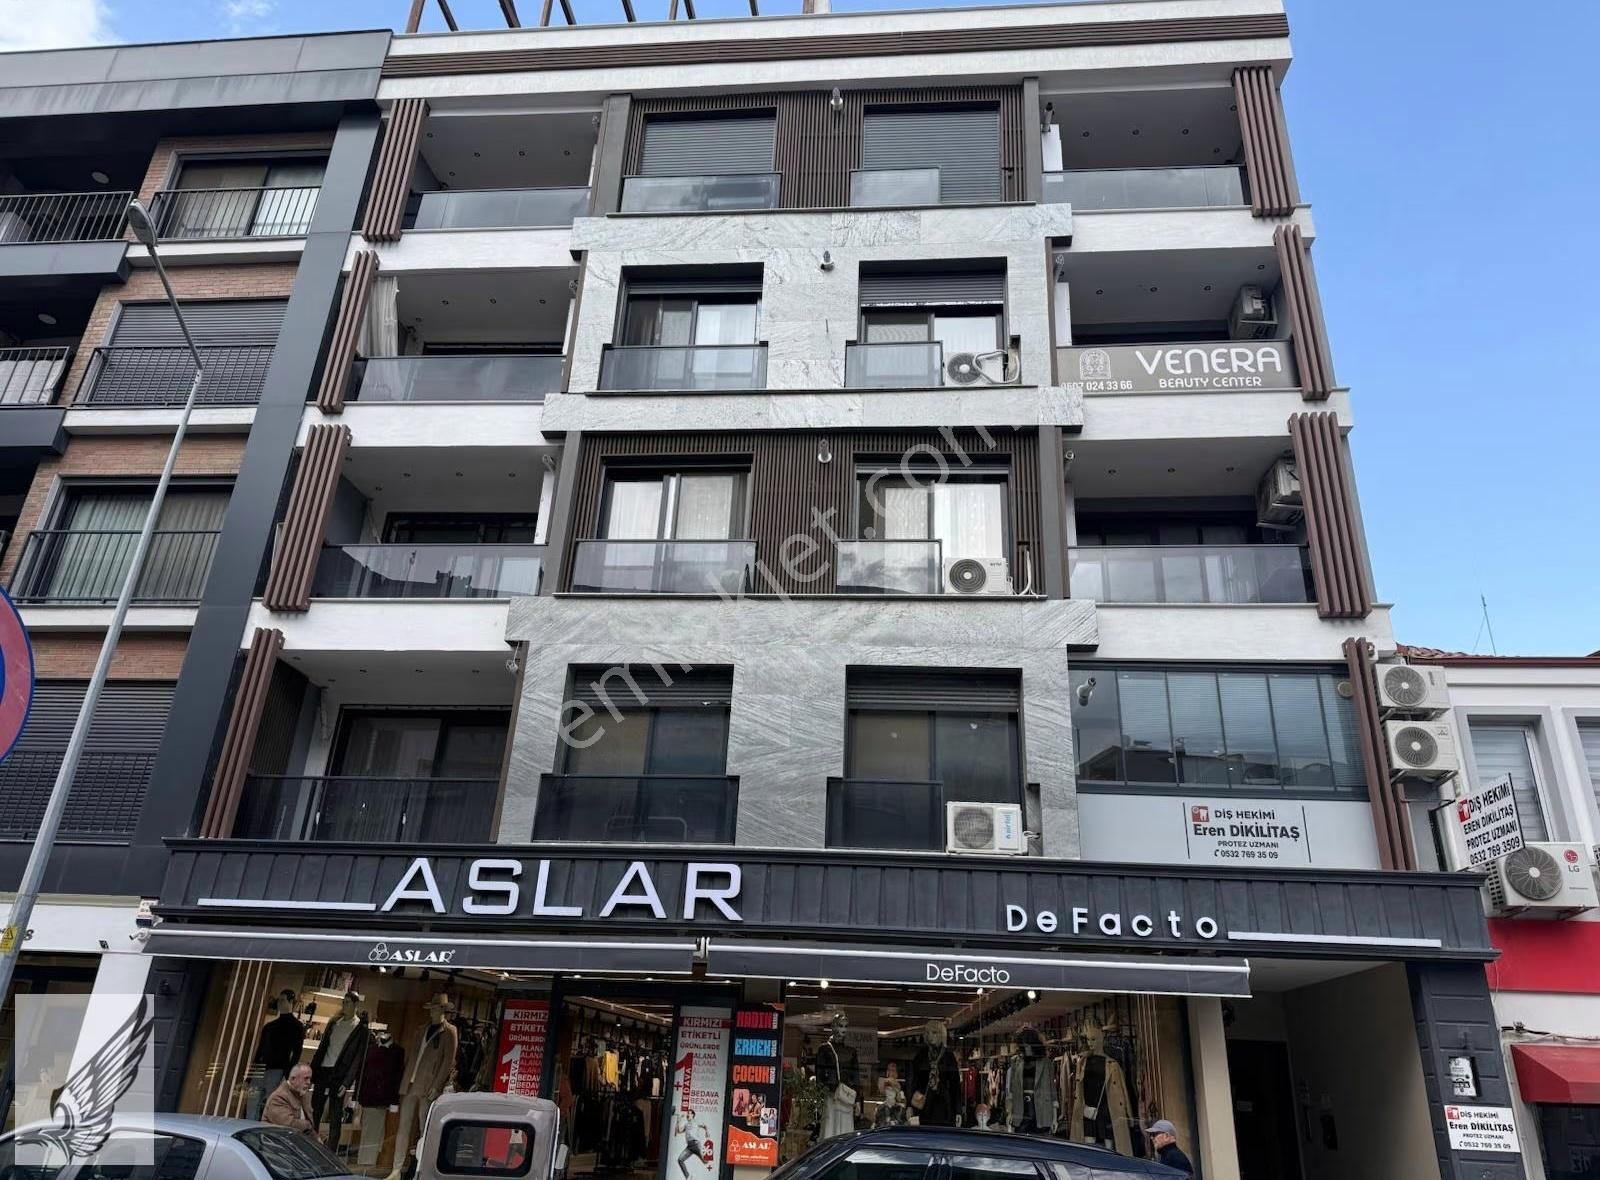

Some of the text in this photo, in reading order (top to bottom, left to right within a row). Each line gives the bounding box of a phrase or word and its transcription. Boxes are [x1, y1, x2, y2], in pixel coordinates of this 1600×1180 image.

[1135, 347, 1282, 375] VENERA
[1086, 381, 1105, 391] 024
[1107, 381, 1119, 391] 33
[1159, 376, 1262, 389] BEAUTY CENTER
[1481, 781, 1511, 807] HEKİMİ
[1214, 809, 1275, 820] DİŞ HEKİMİ
[1193, 821, 1300, 842] Eren DİKİLİTAŞ
[1463, 819, 1481, 835] EREN
[1466, 820, 1518, 850] PROTEZ UZMANI
[1217, 840, 1279, 849] PROTEZ UZMANI
[1487, 844, 1501, 858] 769
[1502, 836, 1521, 853] 3509
[1220, 850, 1239, 858] 0532
[1567, 864, 1580, 873] LG
[380, 857, 743, 921] ASLAR
[1006, 904, 1219, 940] DeFacto
[388, 949, 451, 963] ASLAR
[926, 963, 1010, 984] DeFacto
[513, 1011, 548, 1020] KIRMIZ
[510, 1022, 547, 1033] ETİKETL
[683, 1016, 722, 1028] KIRMIZI
[508, 1033, 546, 1043] ÜRÜNLERD
[517, 1074, 541, 1082] BEDAV
[690, 1090, 719, 1098] BEDAVA
